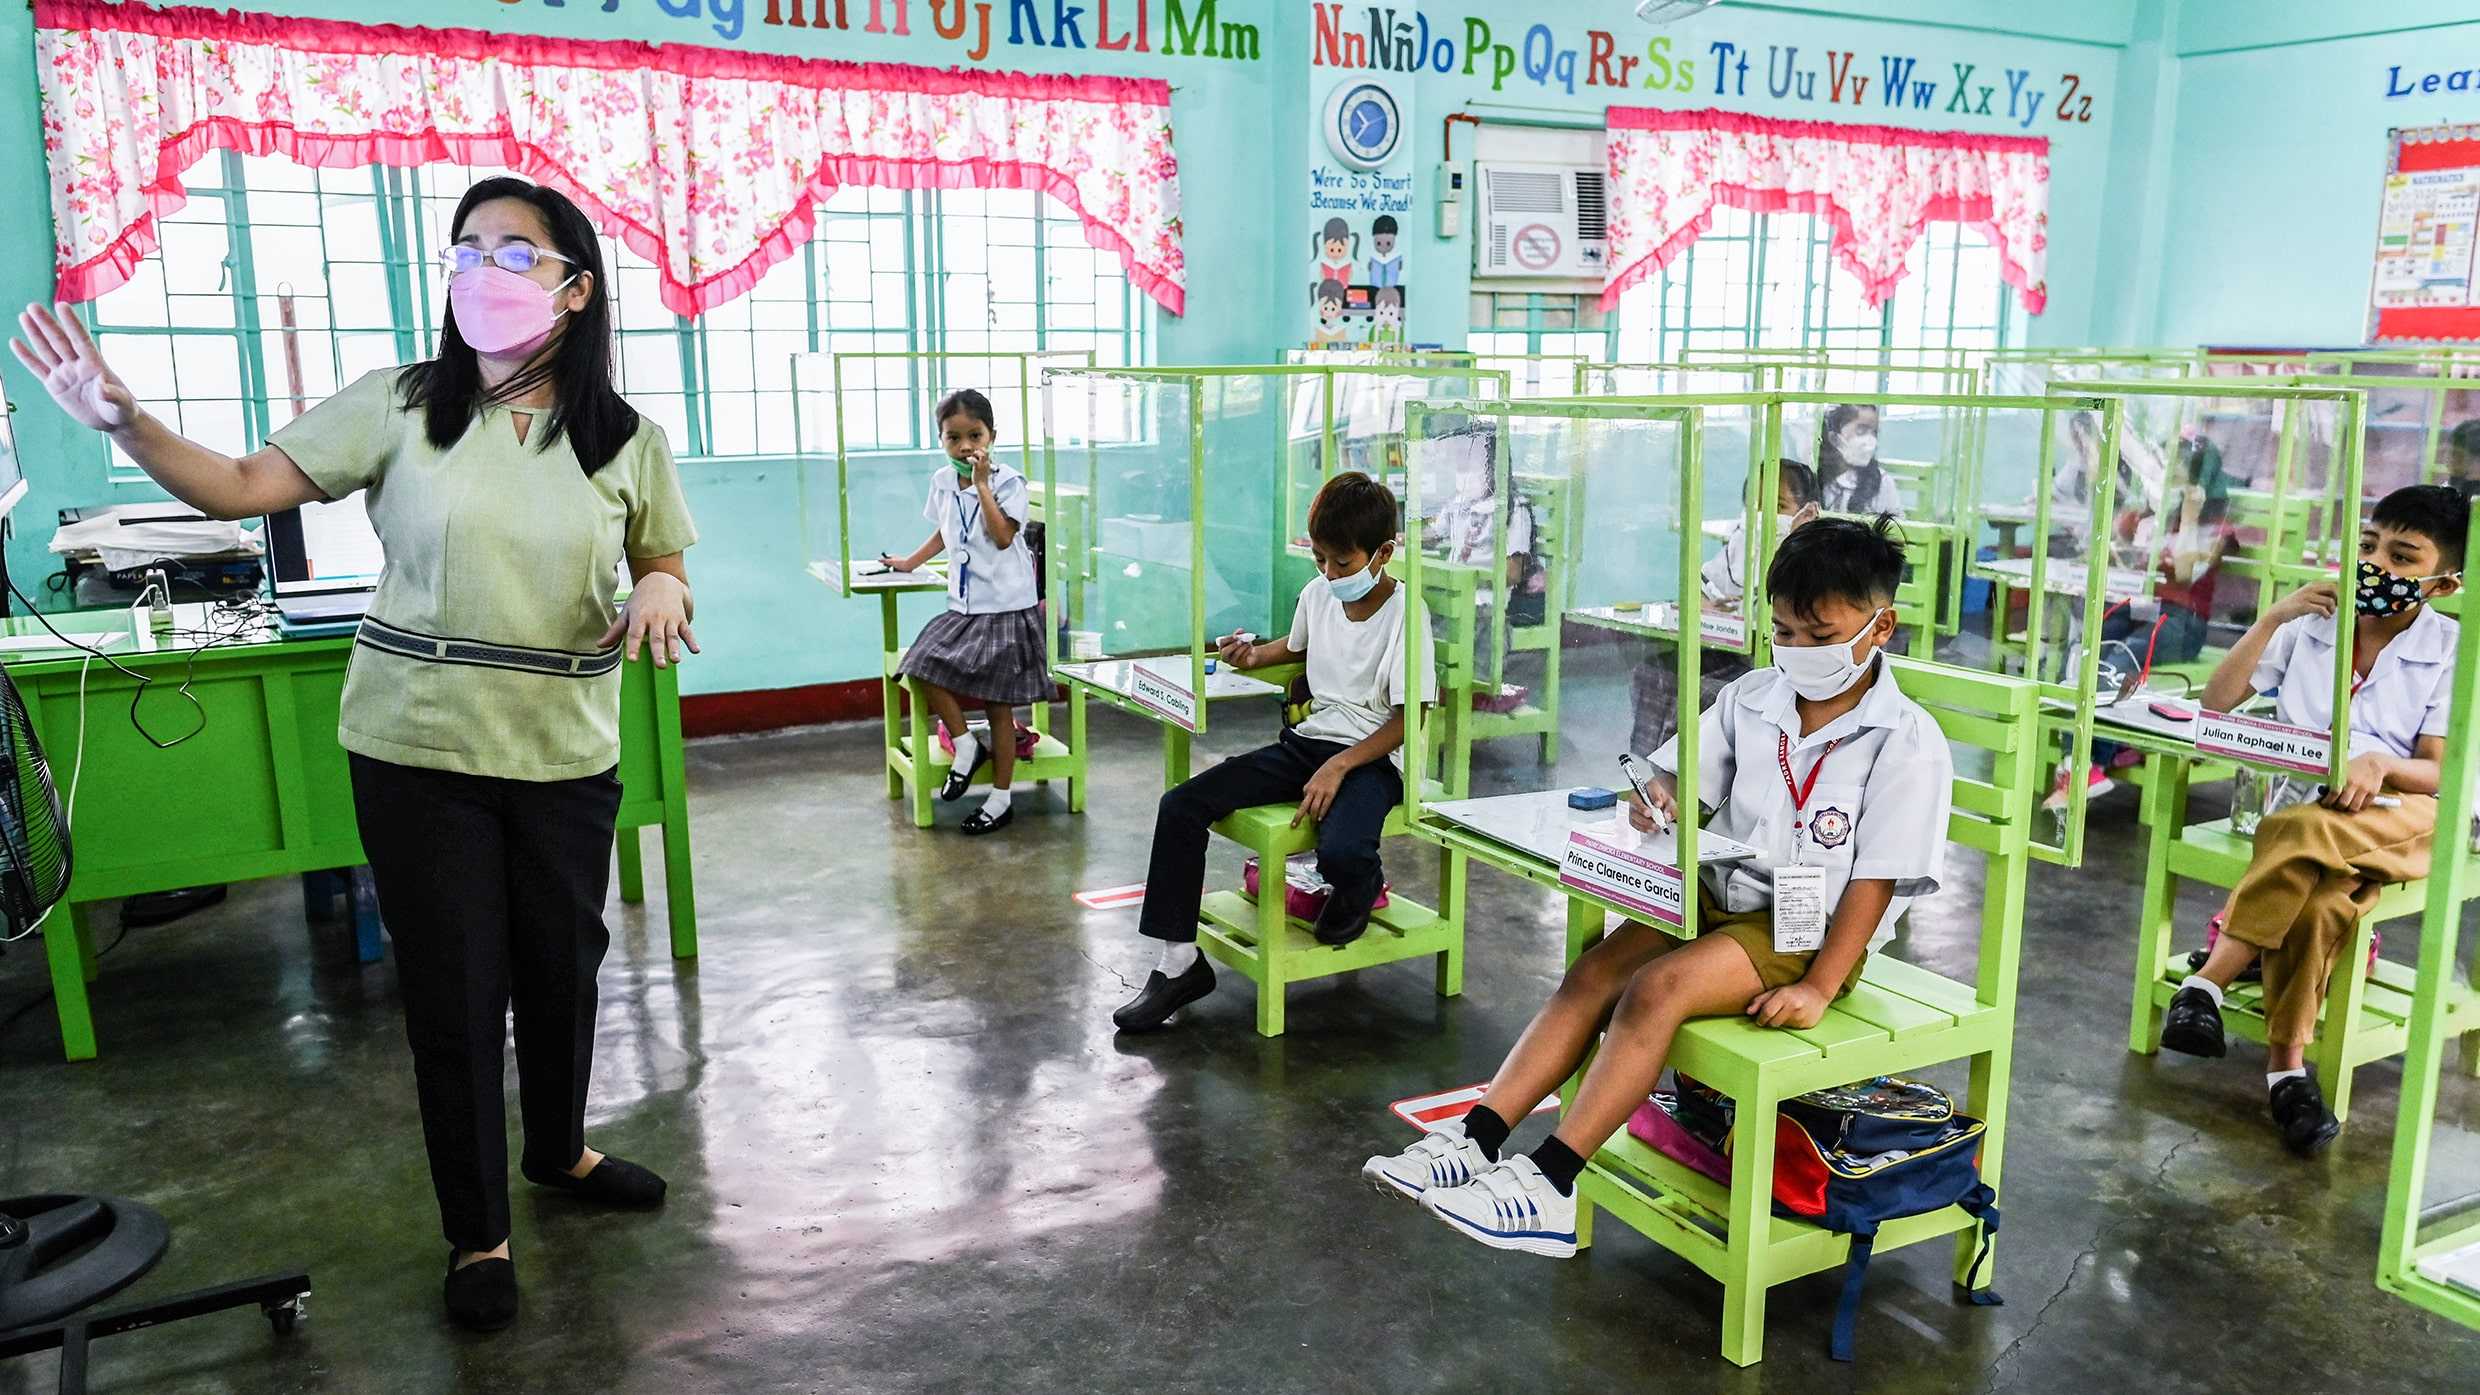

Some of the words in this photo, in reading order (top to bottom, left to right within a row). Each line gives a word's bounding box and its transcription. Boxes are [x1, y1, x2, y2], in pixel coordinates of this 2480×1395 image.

[1160, 0, 1261, 60] Mm
[1313, 3, 1366, 69] Nn
[1462, 17, 1515, 91] Pp
[1523, 23, 1577, 95] Qq
[1586, 30, 1639, 88] Rr
[1644, 36, 1694, 93] Ss
[1710, 41, 1749, 96] Tt
[1768, 45, 1816, 101] Uu
[1827, 51, 1869, 105] Vv
[1881, 55, 1937, 110] Ww
[1946, 63, 1995, 115] Xx
[2005, 68, 2045, 128] Yy
[2057, 73, 2093, 123] Zz
[2386, 66, 2480, 97] Lea
[1351, 170, 1367, 188] So
[1373, 171, 1411, 189] Smart
[1311, 191, 1357, 209] Because
[1360, 192, 1377, 211] We
[1138, 680, 1160, 697] Edward
[1166, 694, 1190, 715] Cabling
[2202, 727, 2234, 742] Julian
[2237, 733, 2284, 752] Raphael
[2287, 743, 2298, 755] N.
[2302, 746, 2323, 759] Lee
[1567, 850, 1594, 872] Prince
[1596, 862, 1641, 889] Clarence
[1644, 879, 1680, 902] Garcia
[1645, 860, 1665, 874] SCHOOL
